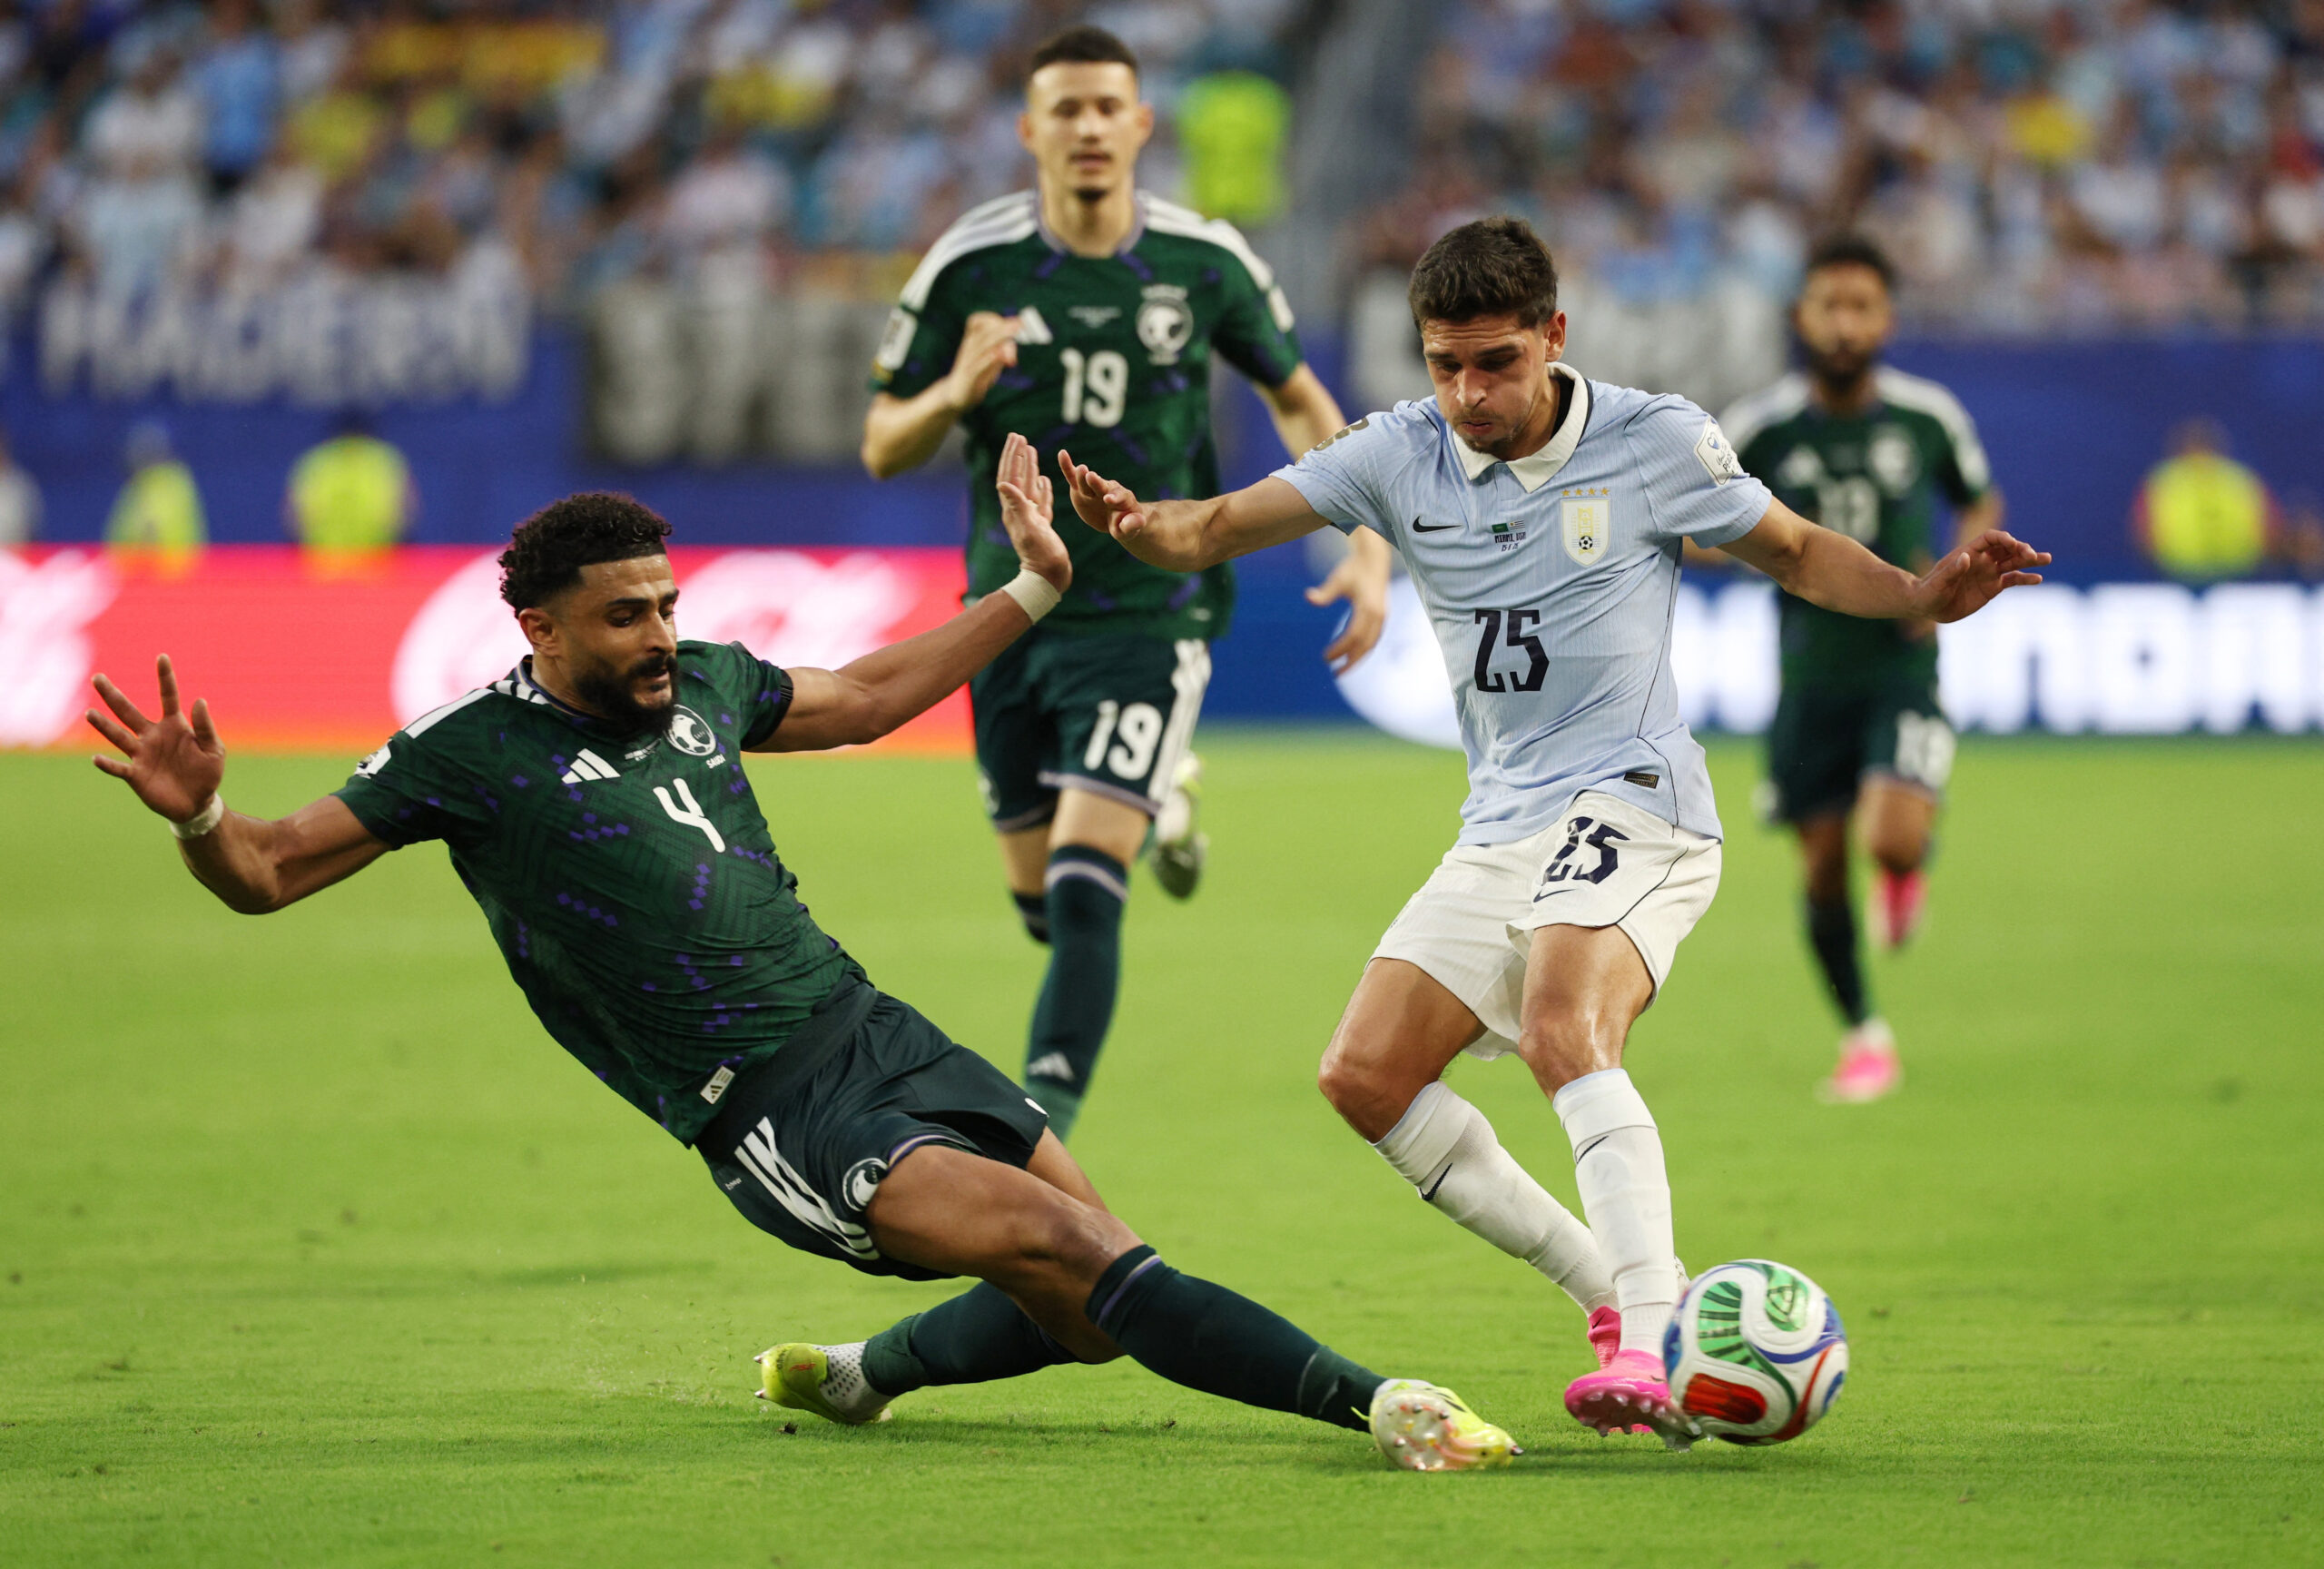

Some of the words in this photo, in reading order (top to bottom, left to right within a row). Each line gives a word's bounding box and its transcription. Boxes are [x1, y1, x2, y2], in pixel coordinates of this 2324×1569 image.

[1059, 348, 1129, 427] 19
[1474, 609, 1550, 693] 25
[1084, 699, 1163, 780] 19
[653, 777, 726, 854] 4
[1541, 816, 1630, 886] 25
